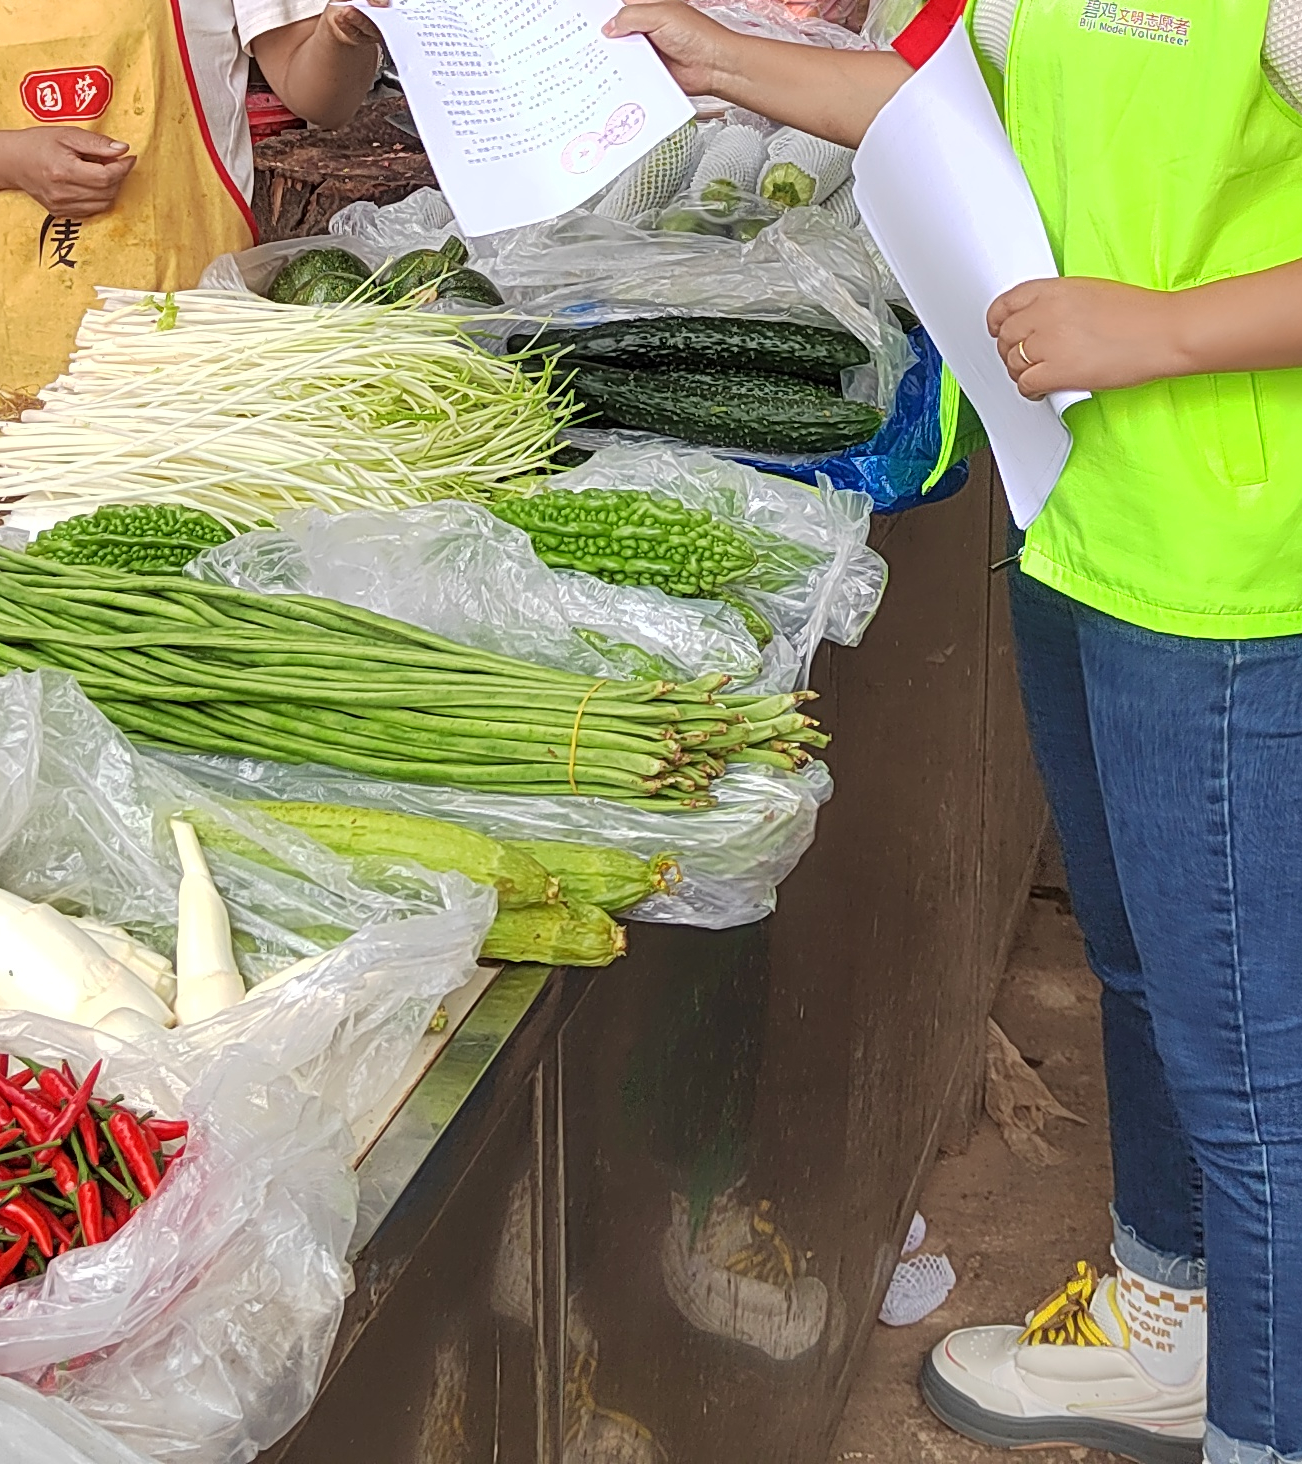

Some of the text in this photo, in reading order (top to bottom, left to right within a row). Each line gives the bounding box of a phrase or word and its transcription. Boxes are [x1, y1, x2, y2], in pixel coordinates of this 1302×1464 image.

[1079, 17, 1189, 47] Biji Model Volunteer
